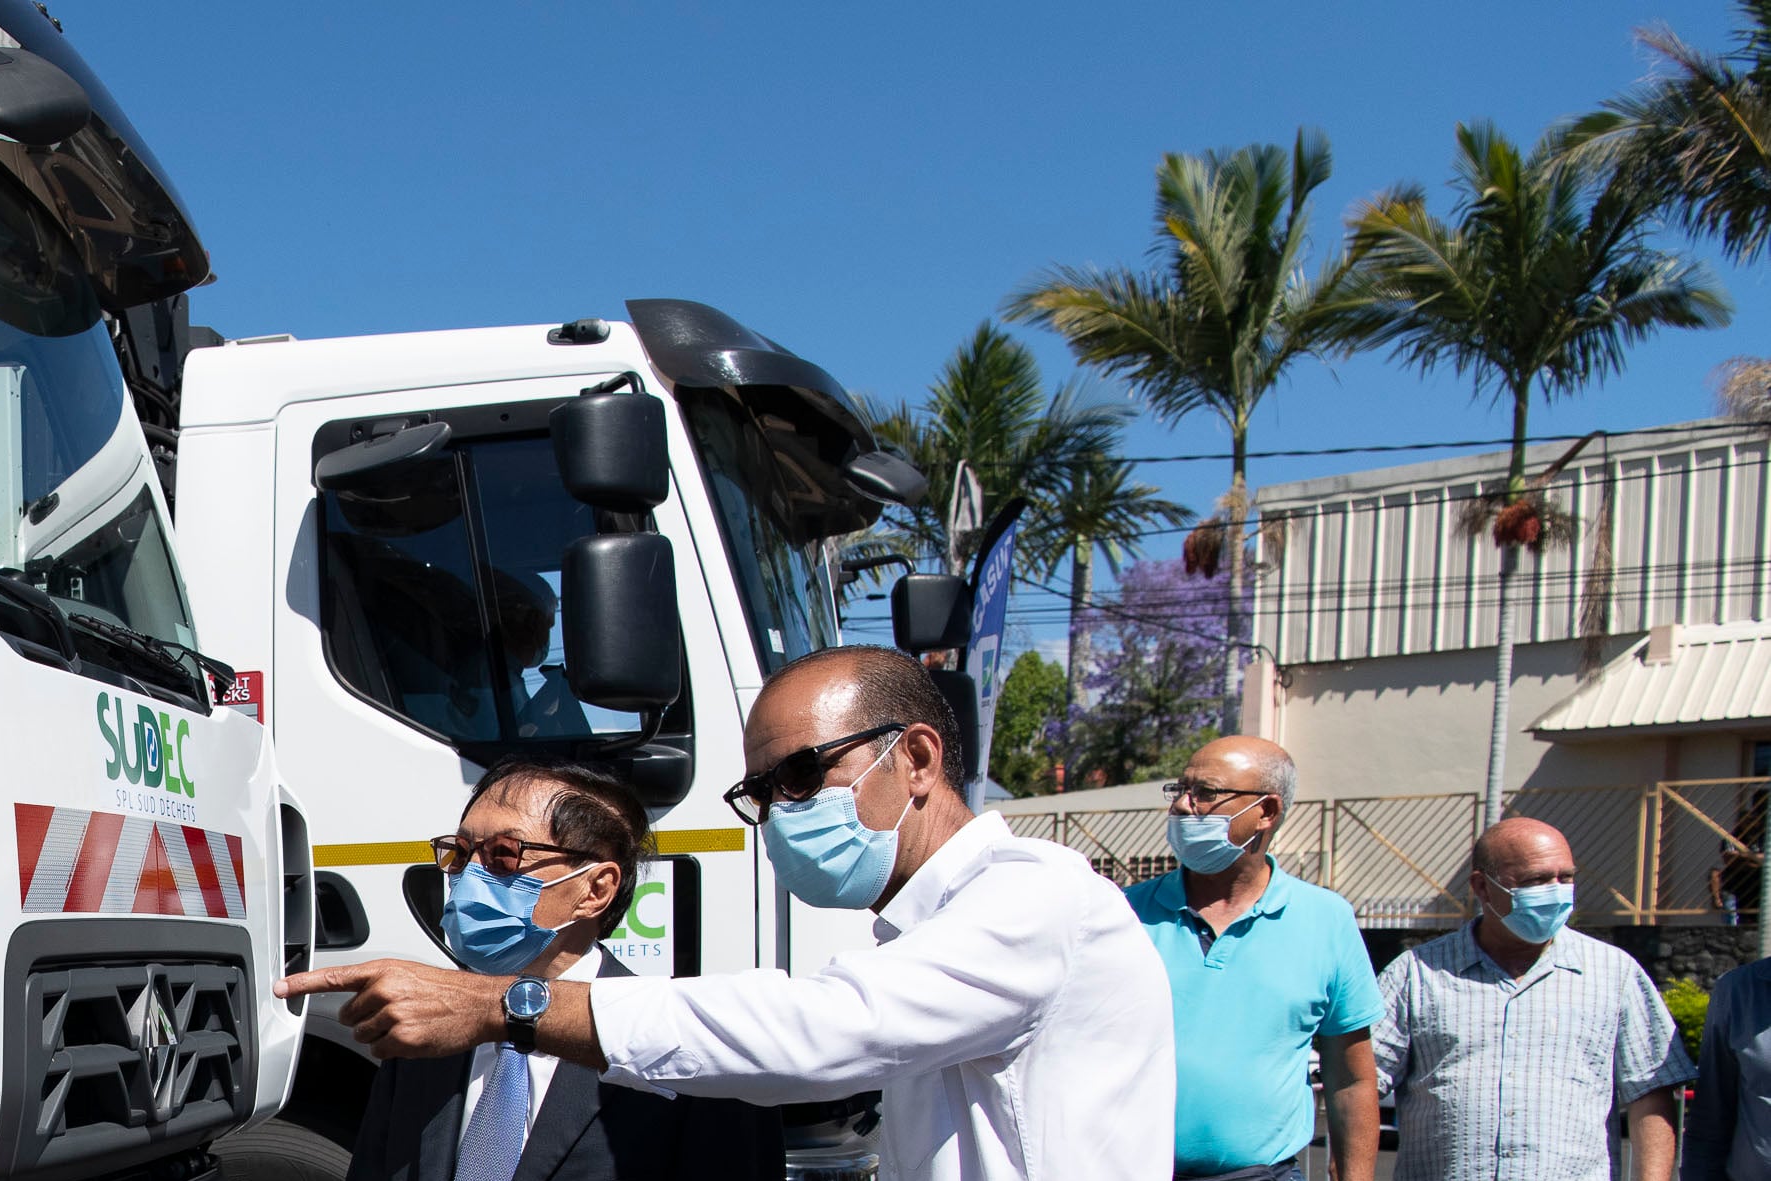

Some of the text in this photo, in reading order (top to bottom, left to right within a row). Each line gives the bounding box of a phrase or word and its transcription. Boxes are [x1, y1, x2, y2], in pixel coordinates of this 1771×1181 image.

[97, 691, 195, 798] SUDEC
[116, 789, 133, 810] SPL
[138, 793, 156, 814] SUD
[613, 943, 661, 957] HETS
